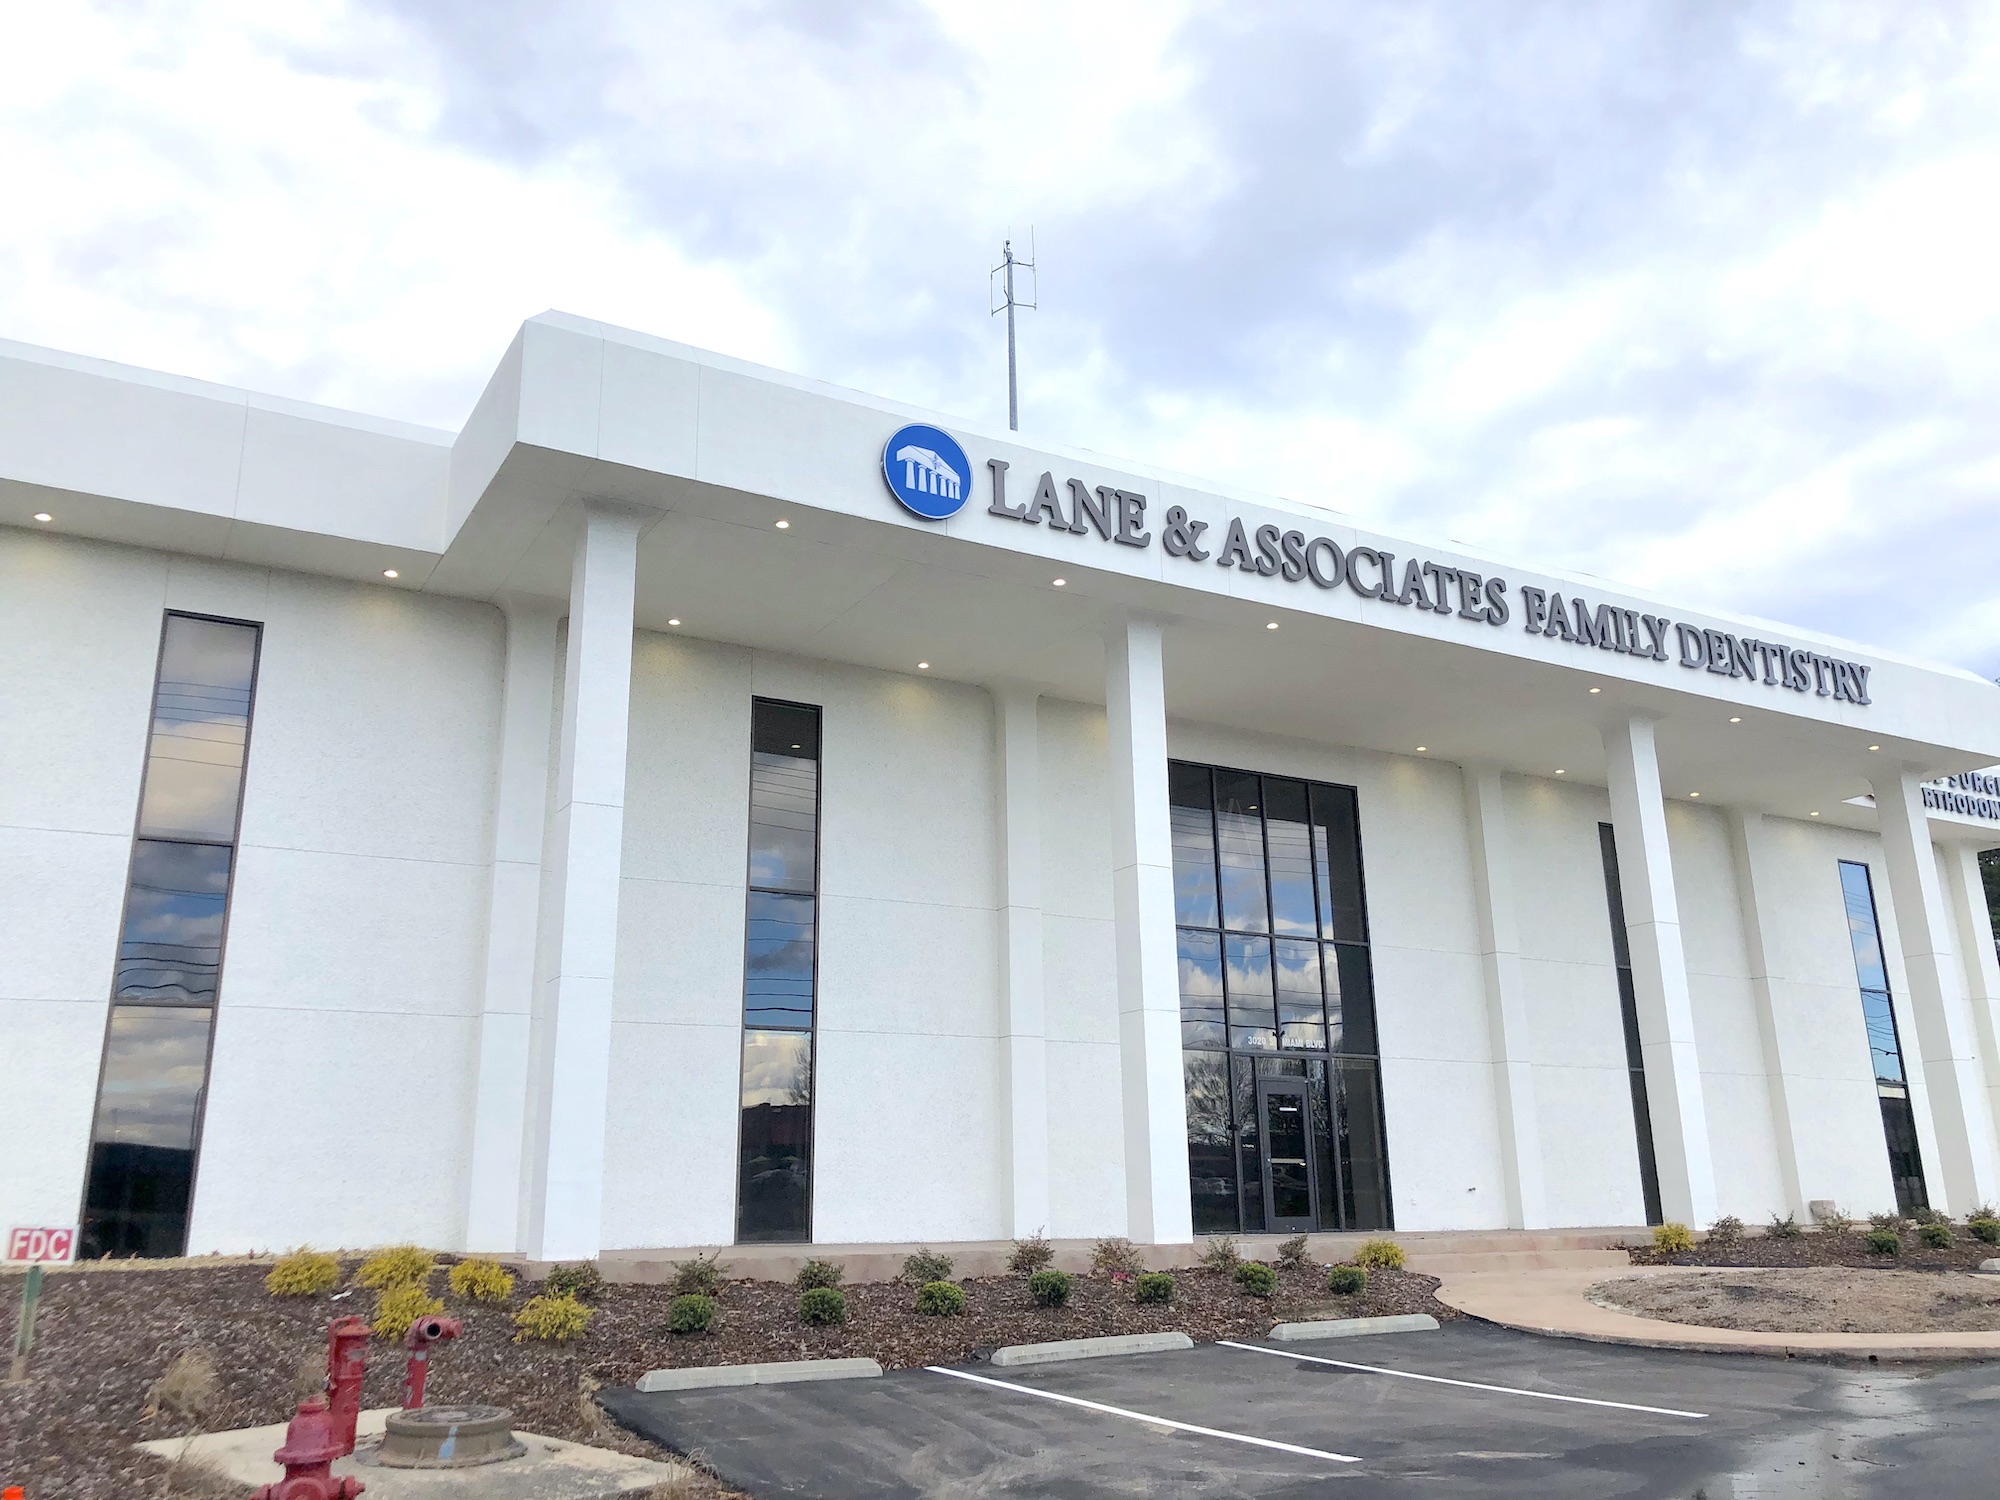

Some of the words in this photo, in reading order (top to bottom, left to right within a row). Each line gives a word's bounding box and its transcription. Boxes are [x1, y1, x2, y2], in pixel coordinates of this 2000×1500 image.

[987, 458, 1152, 548] LANE
[1162, 505, 1210, 562] &
[1217, 517, 1510, 626] ASSOCIATES
[1521, 585, 1671, 662] FAMILY
[1675, 622, 1873, 705] DENTISTRY
[1247, 1036, 1267, 1046] 3020
[1282, 1037, 1304, 1048] MIAMI
[10, 1230, 69, 1259] FDC
